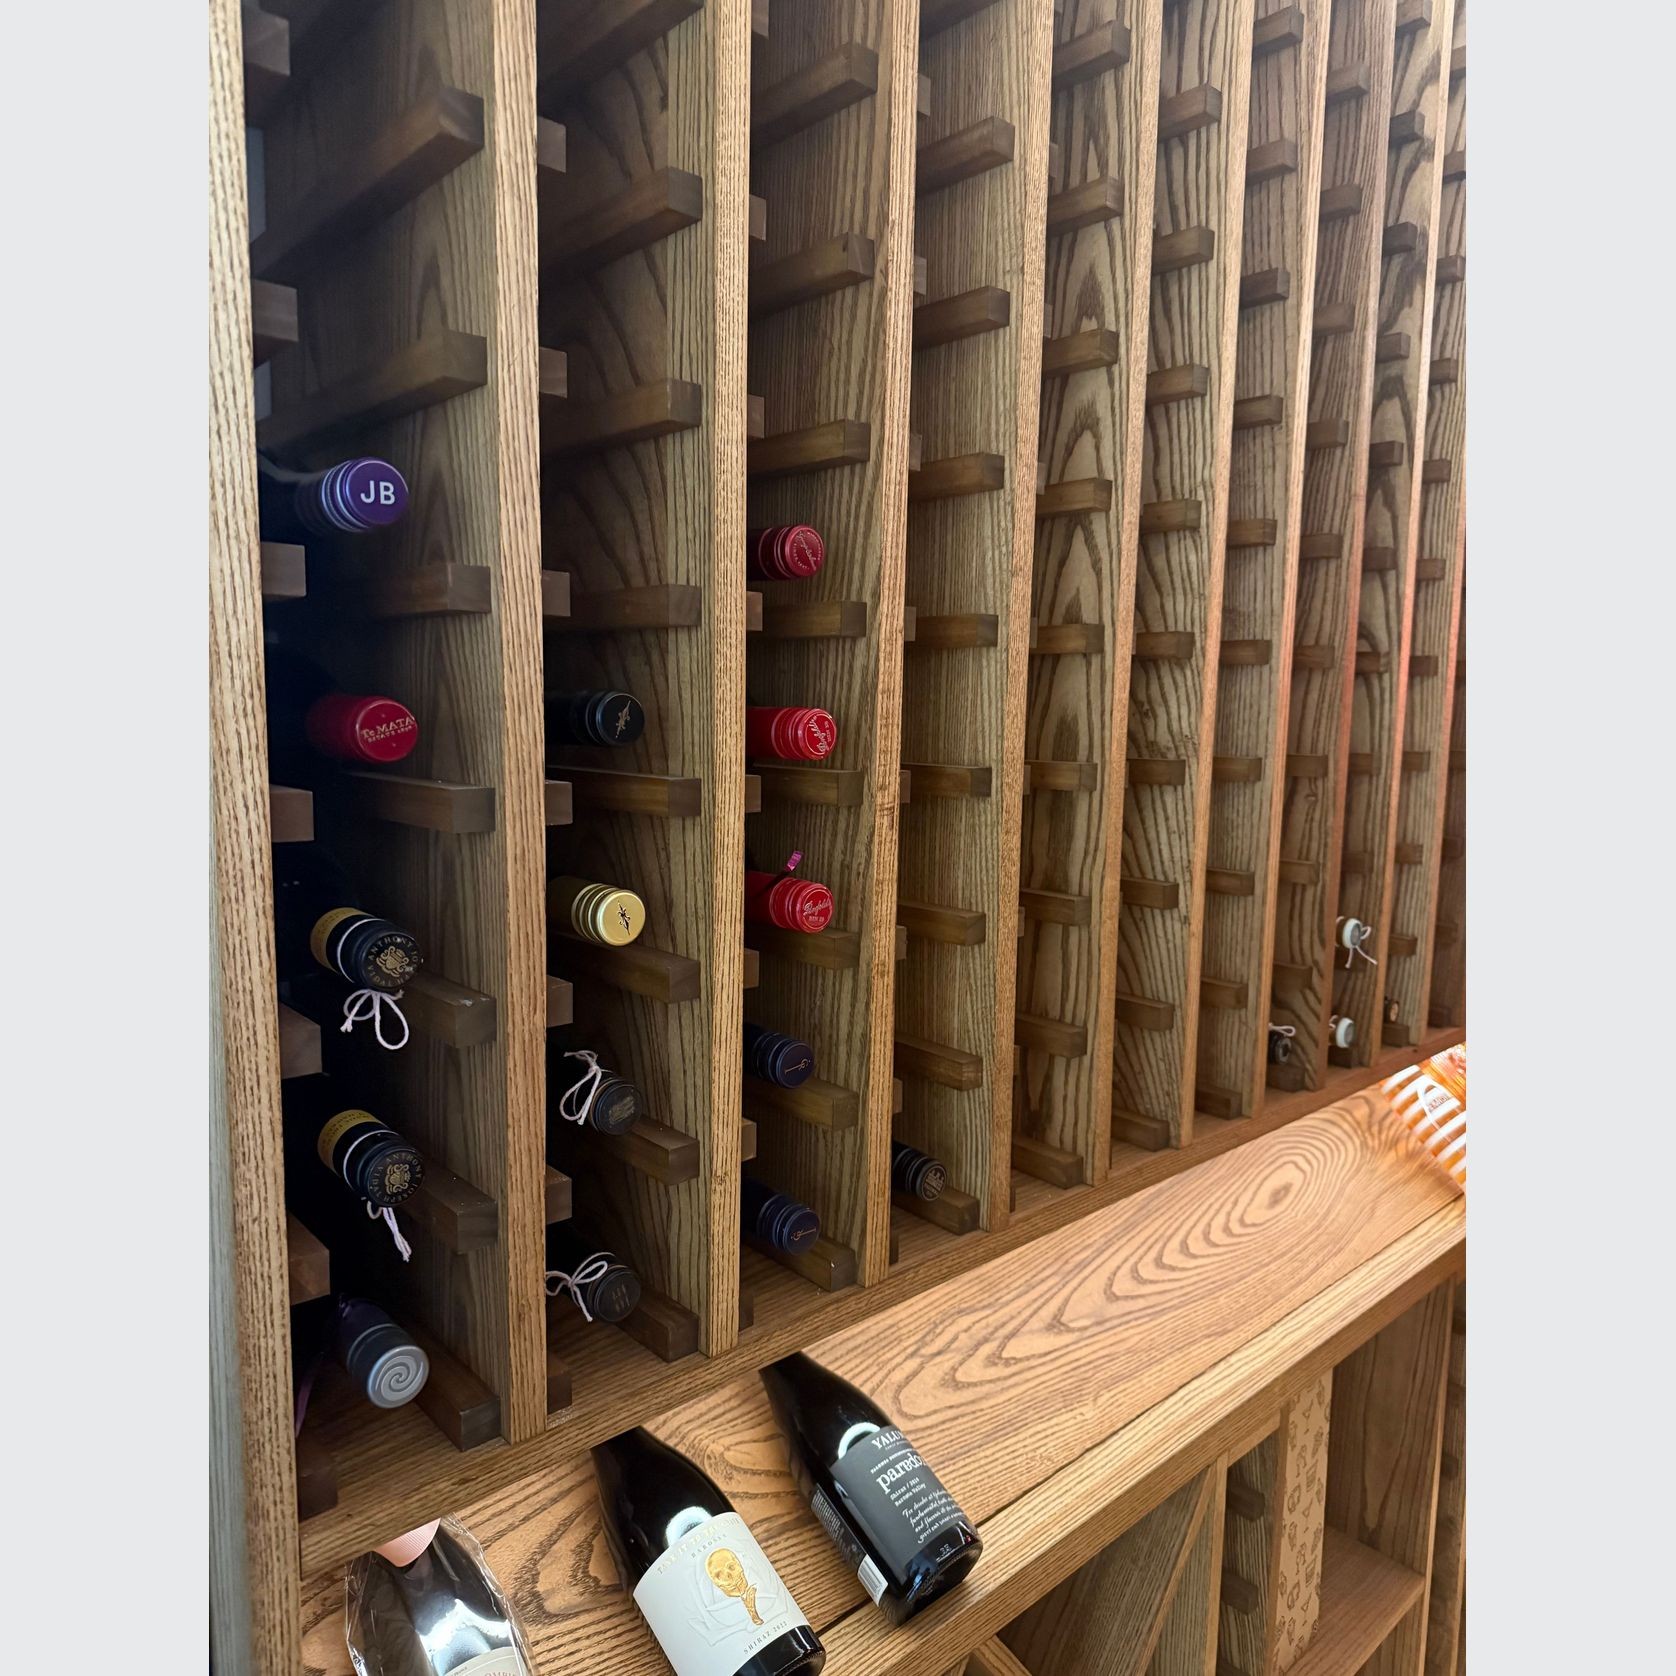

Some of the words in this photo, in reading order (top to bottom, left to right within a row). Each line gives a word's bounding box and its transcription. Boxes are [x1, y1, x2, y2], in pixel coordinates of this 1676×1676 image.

[360, 480, 395, 505] JB
[361, 728, 375, 739] Te
[376, 716, 415, 735] MATA
[744, 1631, 772, 1654] SHIRAZ
